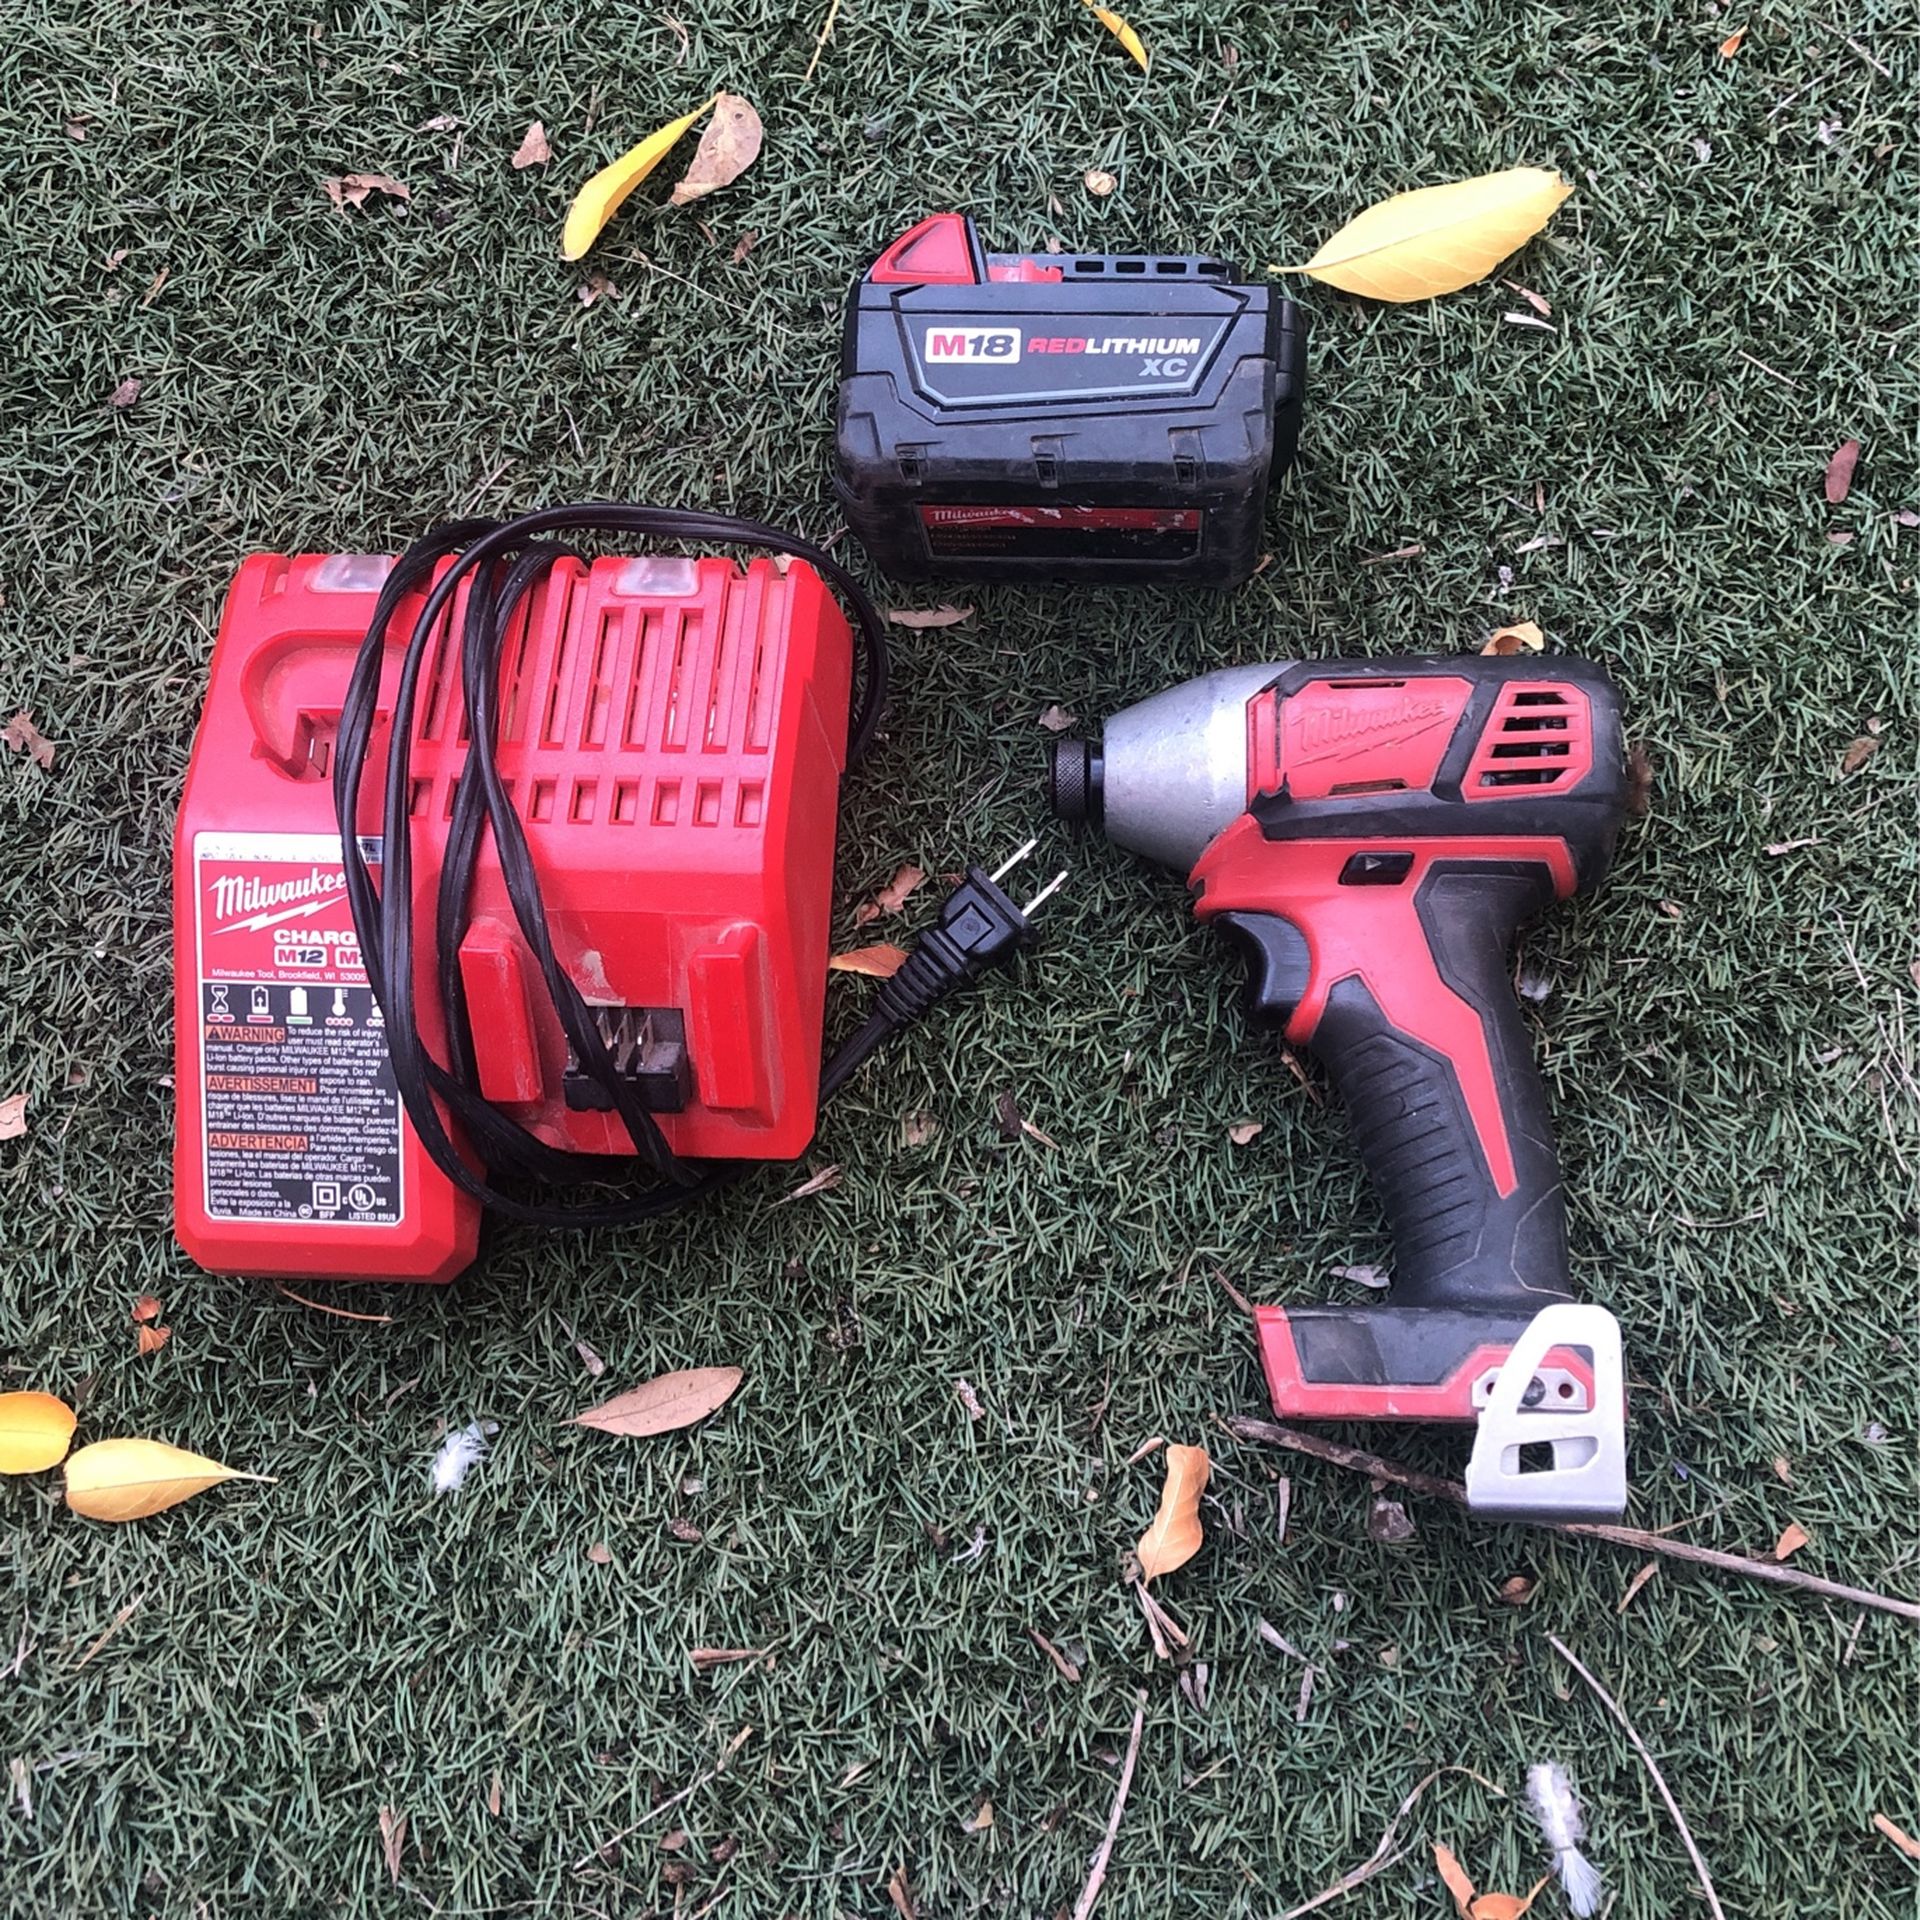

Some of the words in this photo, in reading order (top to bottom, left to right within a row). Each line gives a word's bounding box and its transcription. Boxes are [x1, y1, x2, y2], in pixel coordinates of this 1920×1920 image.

[932, 334, 1014, 356] M18
[1027, 337, 1200, 355] REDLITHIUM
[1139, 358, 1188, 377] XC
[929, 508, 1020, 521] Milwauke
[1290, 696, 1447, 751] Milwaukee
[208, 867, 347, 920] Milwaukee
[274, 929, 357, 945] CHARG
[278, 949, 324, 963] M12
[212, 969, 255, 978] Milwaukee
[257, 970, 275, 979] Tool,
[278, 970, 322, 981] Brookfield,
[324, 972, 335, 980] WI
[340, 973, 366, 981] 53005
[220, 1027, 284, 1042] WARNING
[287, 1026, 297, 1035] To
[298, 1027, 323, 1036] reduce
[324, 1028, 336, 1036] the
[337, 1028, 351, 1037] risk
[352, 1028, 360, 1037] of
[324, 1038, 341, 1046] read
[343, 1039, 379, 1048] operator's
[206, 1044, 235, 1052] manual.
[236, 1044, 263, 1055] Charge
[264, 1045, 280, 1056] only
[281, 1045, 329, 1055] MILWAUKEE
[357, 1048, 371, 1056] and
[228, 1054, 253, 1064] battery
[255, 1055, 278, 1064] packs.
[279, 1056, 301, 1064] Other
[302, 1057, 321, 1066] types
[323, 1057, 331, 1065] of
[332, 1057, 364, 1066] batteries
[365, 1059, 381, 1069] may
[206, 1063, 225, 1071] burst
[226, 1064, 254, 1074] causing
[256, 1065, 287, 1074] personal
[289, 1066, 309, 1076] injury
[319, 1067, 350, 1077] damage.
[352, 1067, 363, 1076] Do
[364, 1068, 377, 1076] not
[208, 1076, 315, 1093] AVERTISSEMENT
[319, 1078, 346, 1086] expose
[320, 1086, 337, 1094] Pour
[338, 1087, 374, 1095] minimiser
[375, 1088, 386, 1096] les
[207, 1093, 230, 1101] risque
[231, 1093, 240, 1101] de
[242, 1093, 279, 1103] blessures,
[280, 1094, 296, 1103] lisez
[298, 1095, 305, 1103] le
[331, 1096, 340, 1104] de
[383, 1097, 395, 1106] Ne
[207, 1102, 235, 1110] charger
[236, 1103, 250, 1111] que
[252, 1102, 263, 1111] les
[264, 1103, 295, 1112] batteries
[297, 1104, 344, 1114] MILWAUKEE
[372, 1107, 380, 1115] et
[289, 1114, 320, 1123] marques
[322, 1115, 332, 1123] de
[333, 1116, 365, 1125] batteries
[241, 1122, 255, 1130] des
[256, 1122, 291, 1132] blessures
[292, 1124, 302, 1132] ou
[303, 1123, 317, 1132] des
[319, 1125, 360, 1135] dommages.
[362, 1125, 398, 1135] Gardez-le
[210, 1134, 306, 1149] ADVERTENCIA
[309, 1143, 327, 1151] Para
[328, 1144, 354, 1153] reducir
[355, 1145, 362, 1153] el
[364, 1146, 386, 1156] riesgo
[388, 1146, 397, 1154] de
[209, 1150, 240, 1159] lesiones,
[242, 1150, 253, 1159] lea
[255, 1151, 262, 1159] el
[263, 1151, 290, 1160] manual
[291, 1152, 303, 1160] del
[304, 1154, 337, 1163] operador.
[340, 1154, 365, 1164] Cargar
[209, 1160, 246, 1168] solamente
[247, 1160, 258, 1169] las
[290, 1162, 300, 1170] de
[301, 1162, 348, 1172] MILWAUKEE
[210, 1180, 240, 1188] provocar
[242, 1179, 272, 1188] lesiones
[258, 1170, 272, 1179] Las
[304, 1172, 314, 1180] de
[315, 1173, 333, 1181] otras
[335, 1174, 362, 1182] marcas
[363, 1174, 392, 1184] pueden
[210, 1189, 249, 1198] personales
[250, 1190, 256, 1198] o
[211, 1197, 228, 1206] Evite
[230, 1198, 237, 1206] la
[284, 1200, 291, 1208] la
[376, 1197, 387, 1206] US
[239, 1208, 262, 1216] Made
[264, 1209, 271, 1217] in
[273, 1209, 297, 1218] China
[348, 1212, 376, 1221] LISTED
